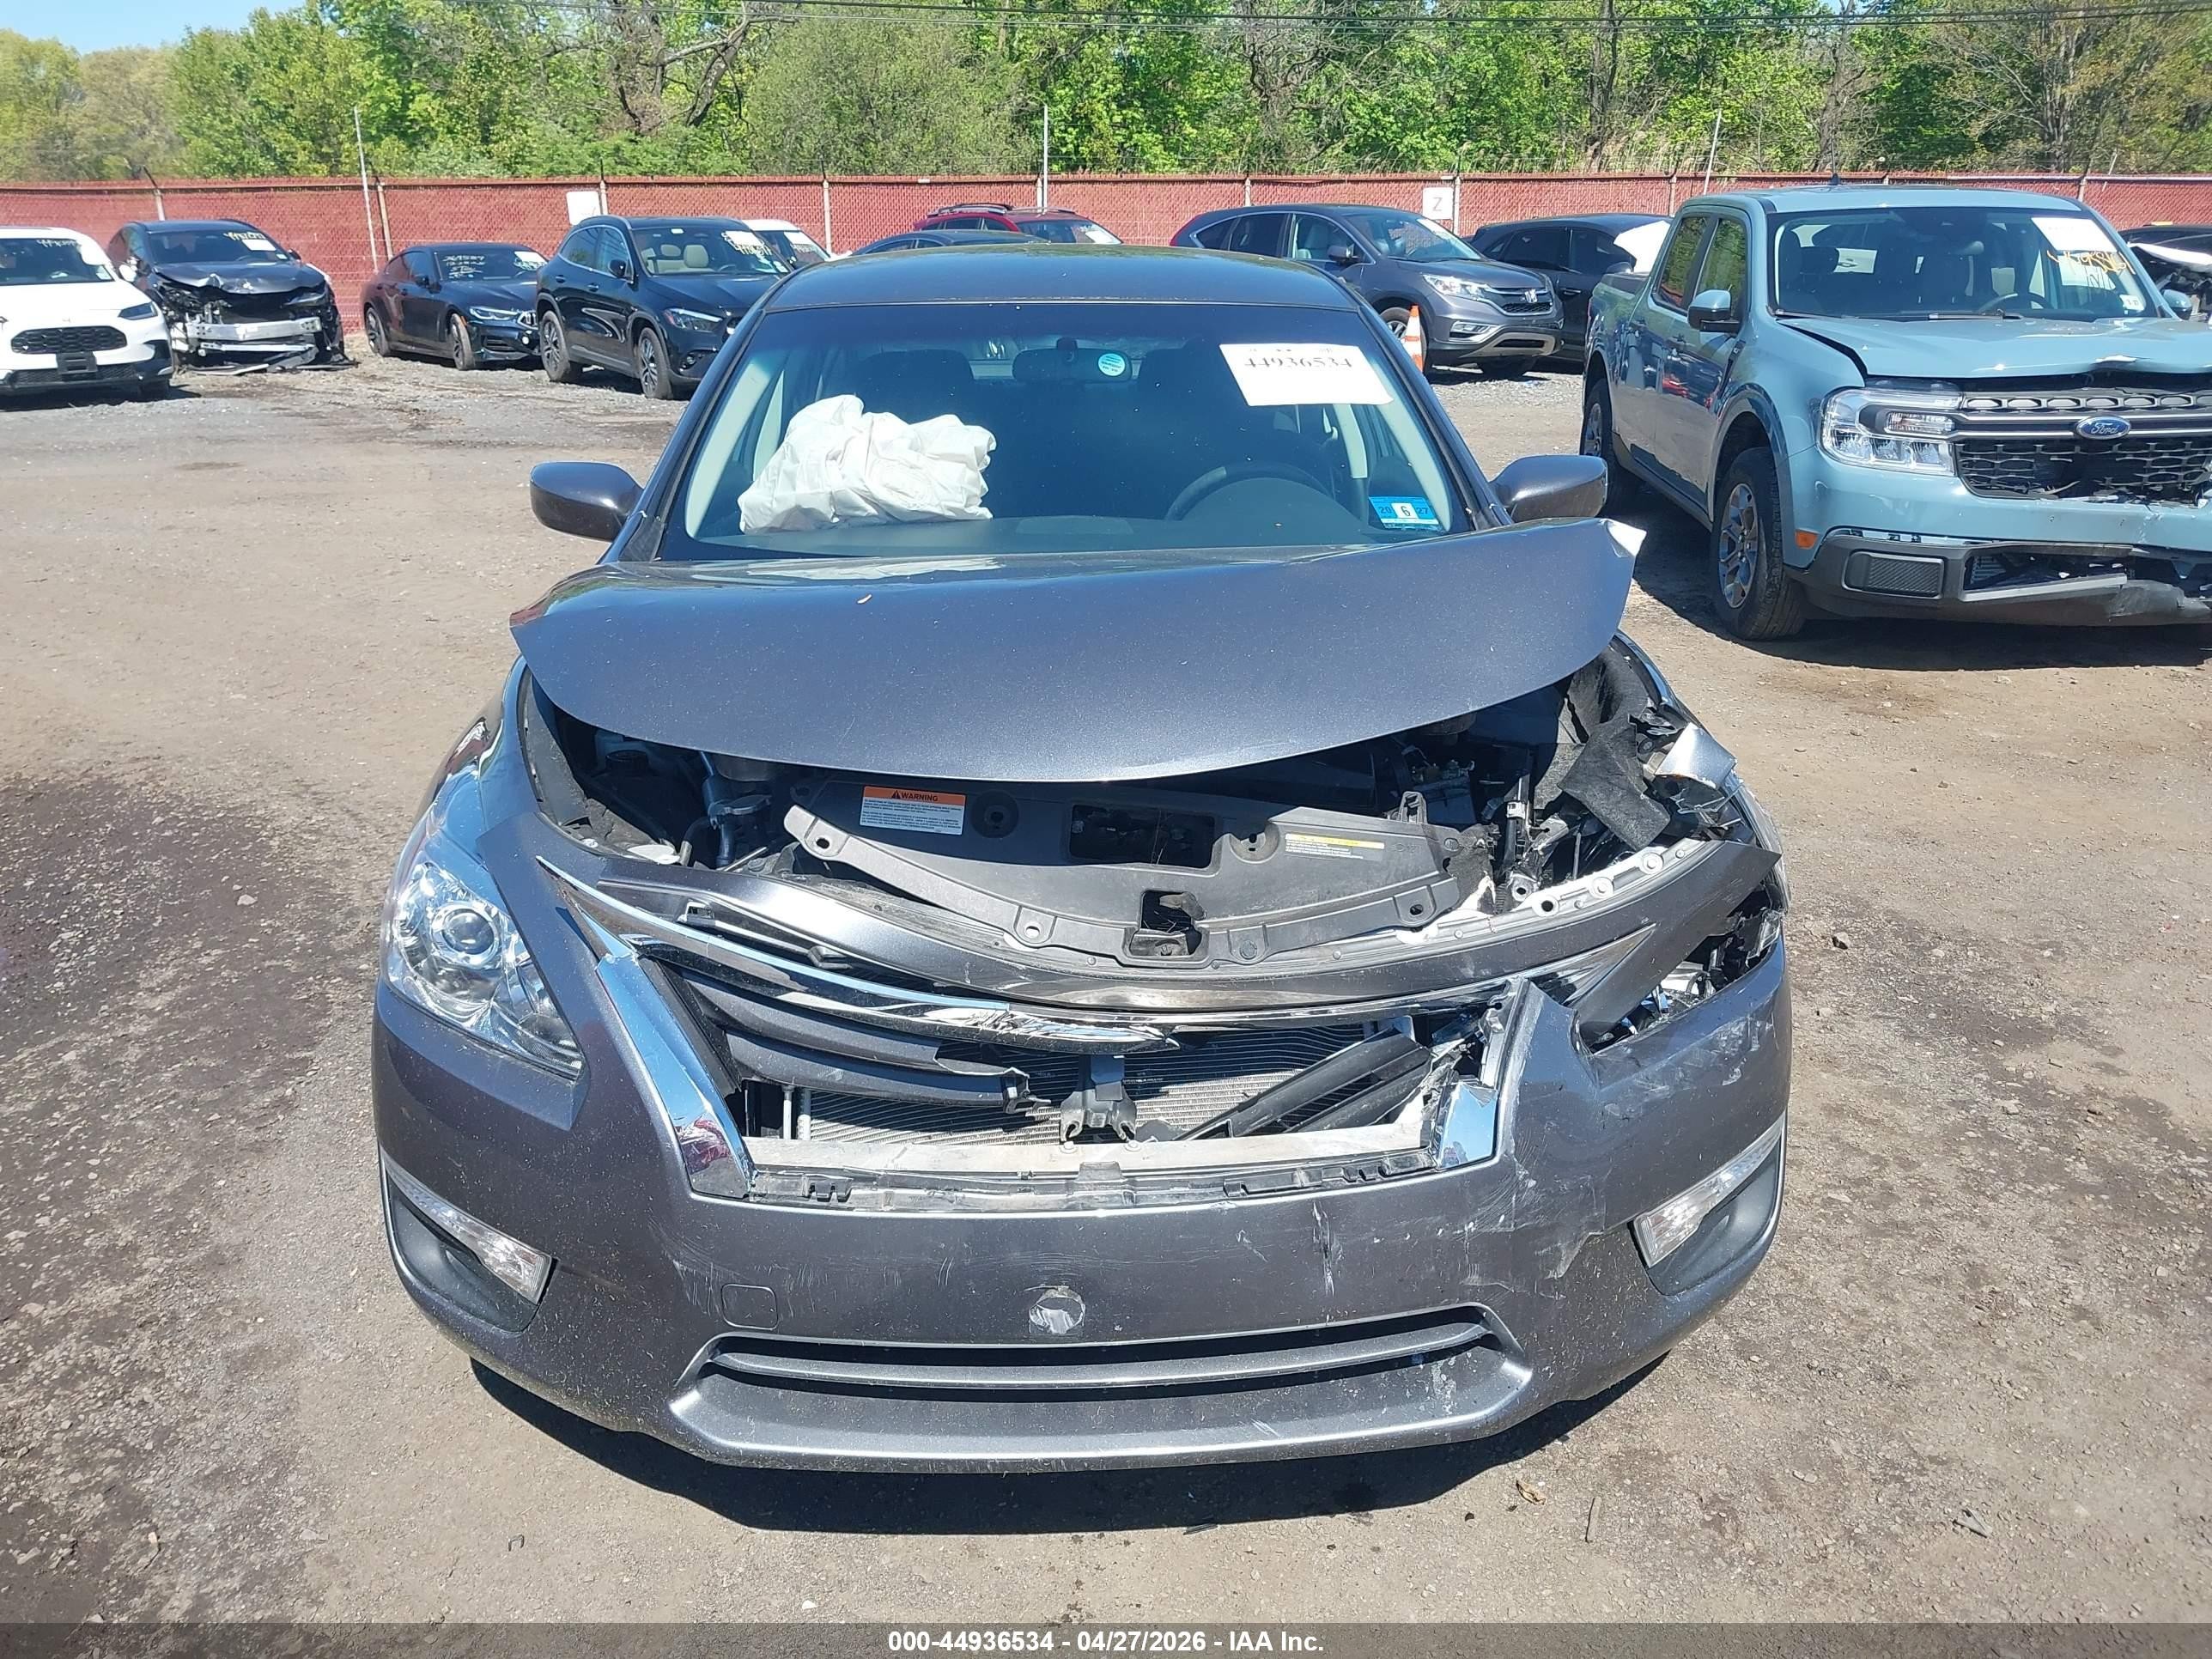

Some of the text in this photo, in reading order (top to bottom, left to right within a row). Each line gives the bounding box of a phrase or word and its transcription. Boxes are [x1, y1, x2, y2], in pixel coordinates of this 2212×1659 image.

[1432, 197, 1443, 212] Z
[1244, 356, 1353, 369] 44936534
[2090, 422, 2120, 434] Ford
[1401, 505, 1412, 517] 6
[1417, 507, 1429, 515] 27
[901, 791, 939, 802] WARNING
